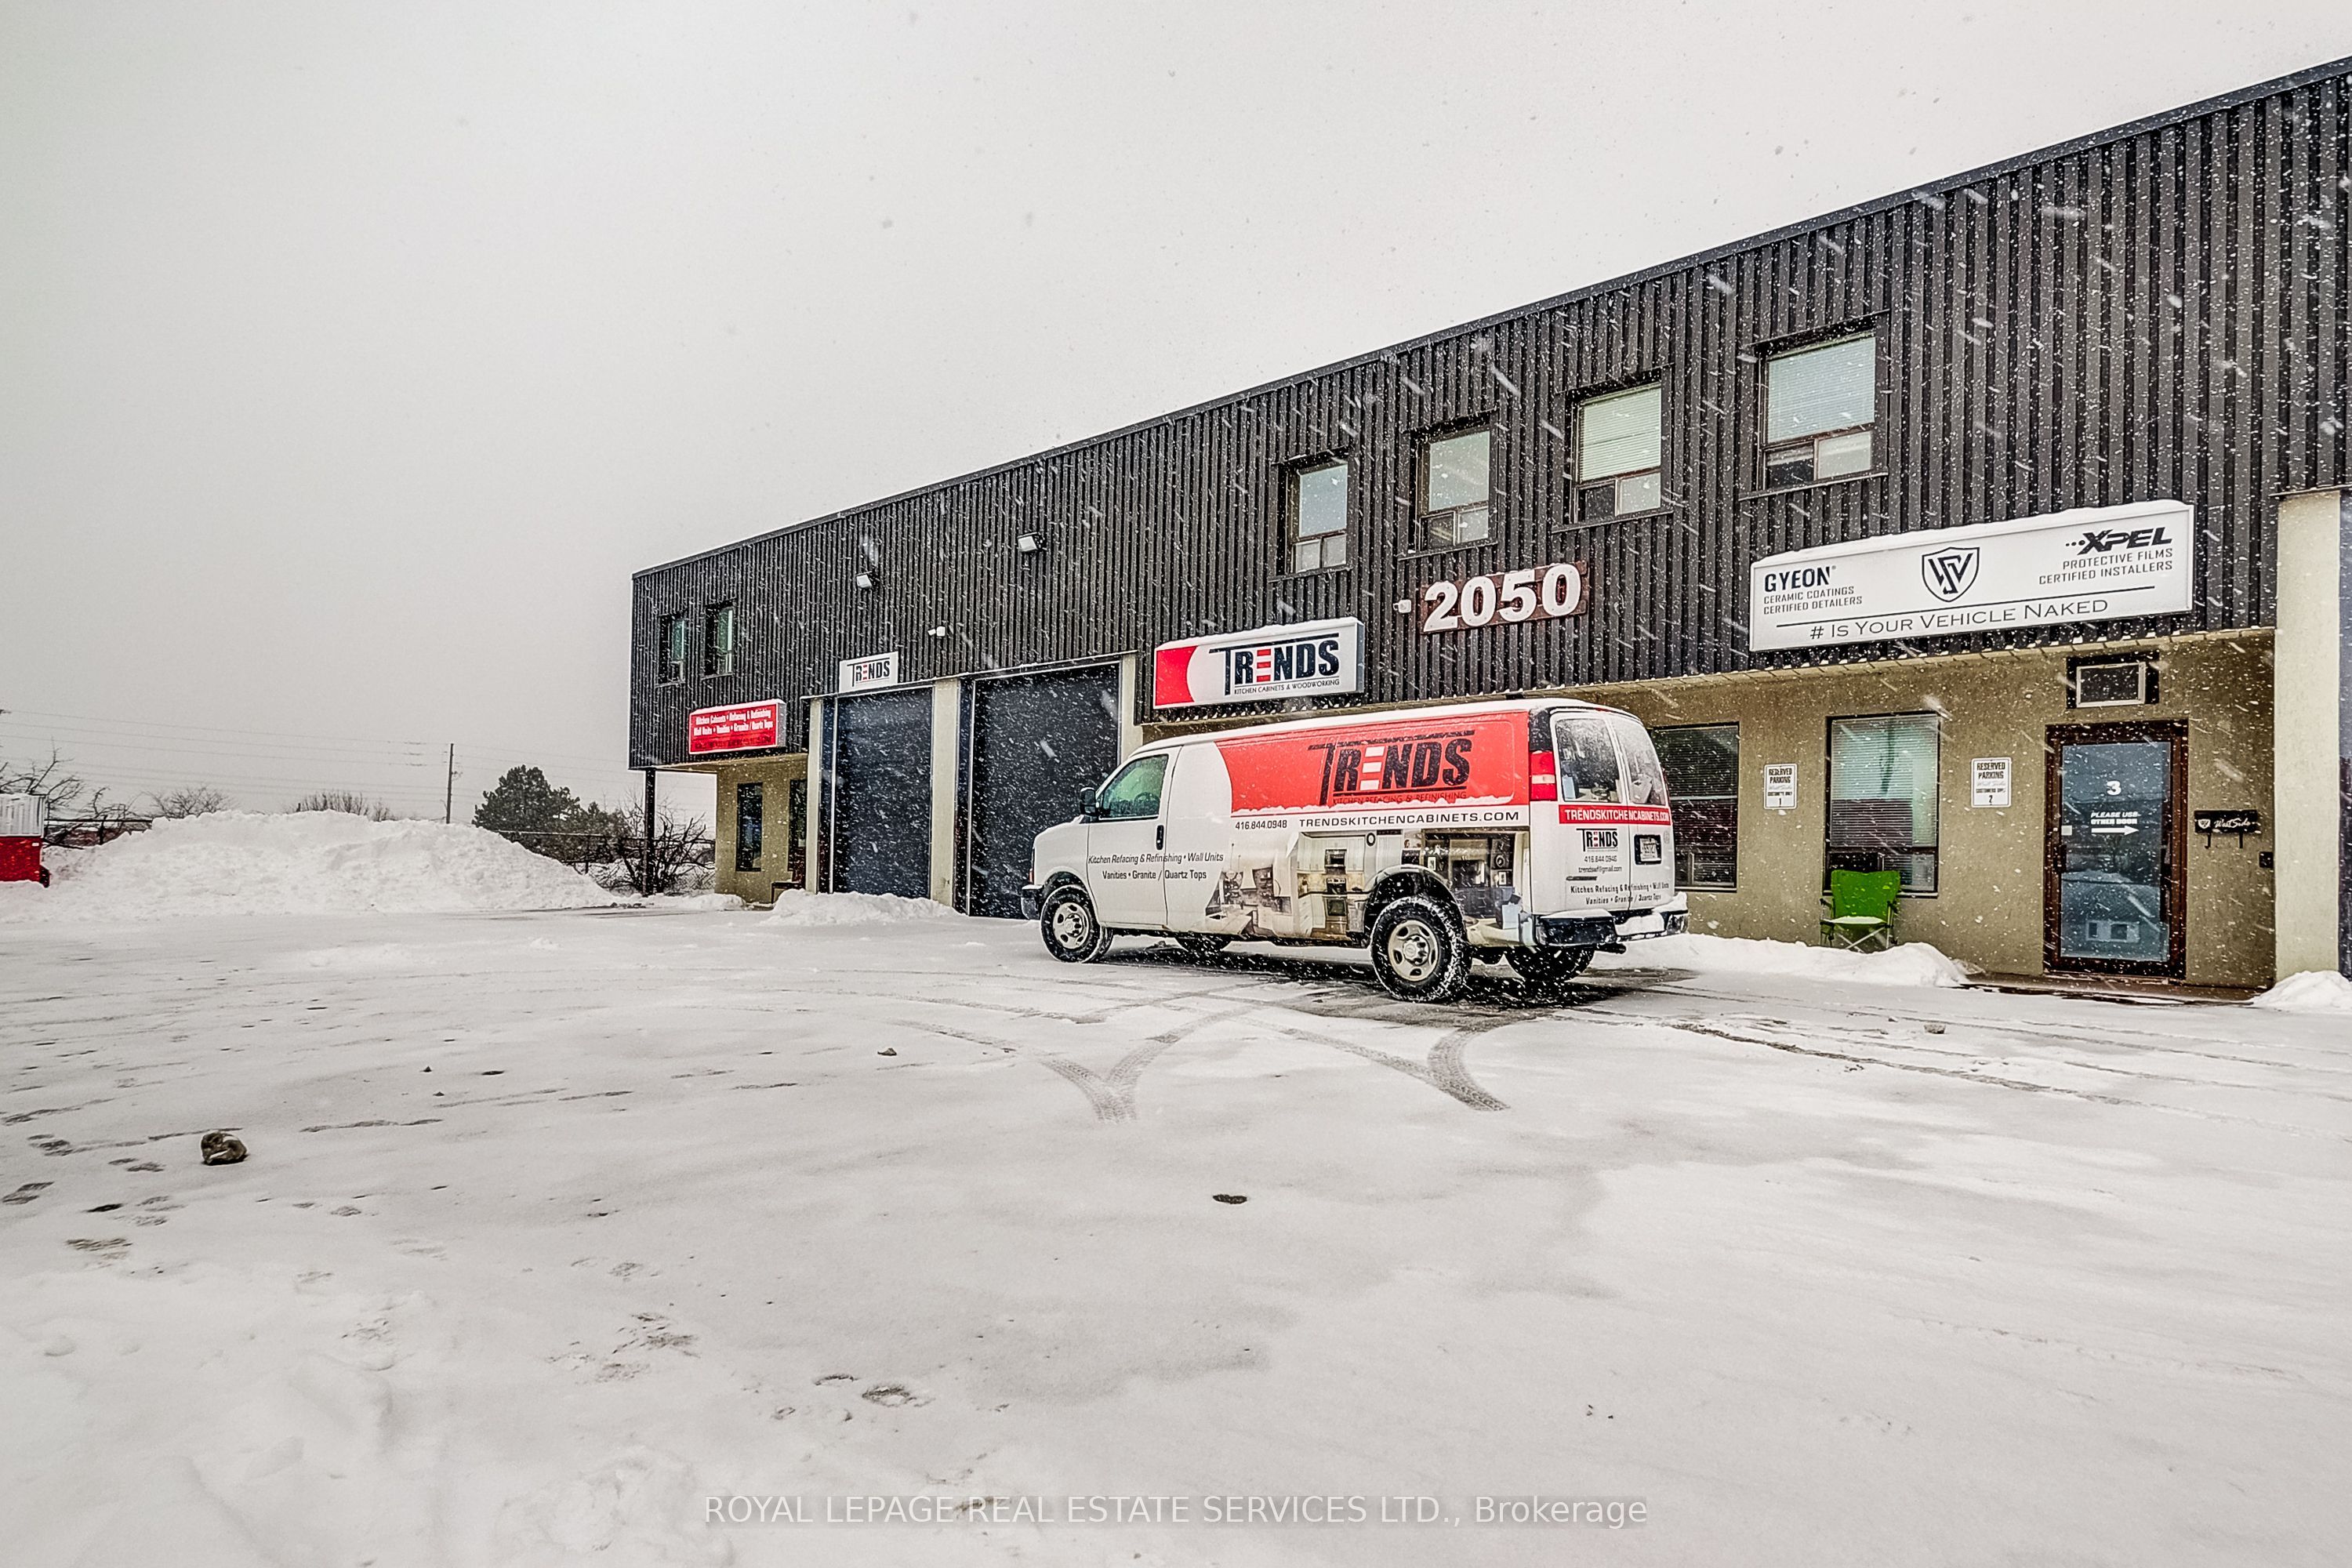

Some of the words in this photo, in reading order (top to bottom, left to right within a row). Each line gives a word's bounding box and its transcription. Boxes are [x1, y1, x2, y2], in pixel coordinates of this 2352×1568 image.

[2077, 527, 2172, 555] XPEL
[2063, 553, 2133, 570] PROTECTIVE
[2137, 549, 2173, 561] FILMS
[1764, 566, 1831, 592] GYEON
[2039, 570, 2096, 585] CERTIFIED
[2100, 561, 2173, 577] INSTALLERS
[1424, 564, 1581, 632] 2050
[1764, 592, 1803, 604] CERAMIC
[1806, 586, 1854, 599] COATINGS
[1764, 602, 1809, 615] CERTIFIED
[1812, 596, 1863, 609] DETAILERS
[1209, 633, 1339, 695] TRENDS
[847, 658, 890, 687] TRENDS
[1258, 684, 1284, 693] CABINETS
[1292, 679, 1340, 689] WOODWORKING
[1308, 730, 1475, 806] TRENDS
[1976, 762, 2005, 771] RESERVED
[1978, 771, 2004, 779] PARKING
[2106, 780, 2122, 796] 3
[1988, 794, 1993, 804] 2
[1299, 811, 1519, 827] TRENDSKITCHENCABINETS.COM
[1564, 809, 1670, 822] TRENDSKITCHENCABINETS.COM
[1235, 820, 1287, 830] 416.844.0948
[1576, 828, 1618, 851] TRENDS
[1088, 855, 1110, 864] Kitchen
[1112, 855, 1138, 865] Refacing
[1145, 854, 1181, 864] Refinishing
[1187, 852, 1203, 862] Wall
[1205, 852, 1224, 862] Units
[1102, 870, 1127, 880] Vanities
[1132, 870, 1156, 880] Granite
[1164, 869, 1188, 880] Quartz
[1189, 869, 1207, 881] Tops
[1595, 884, 1618, 894] Refacing
[1585, 896, 1609, 905] Vanities
